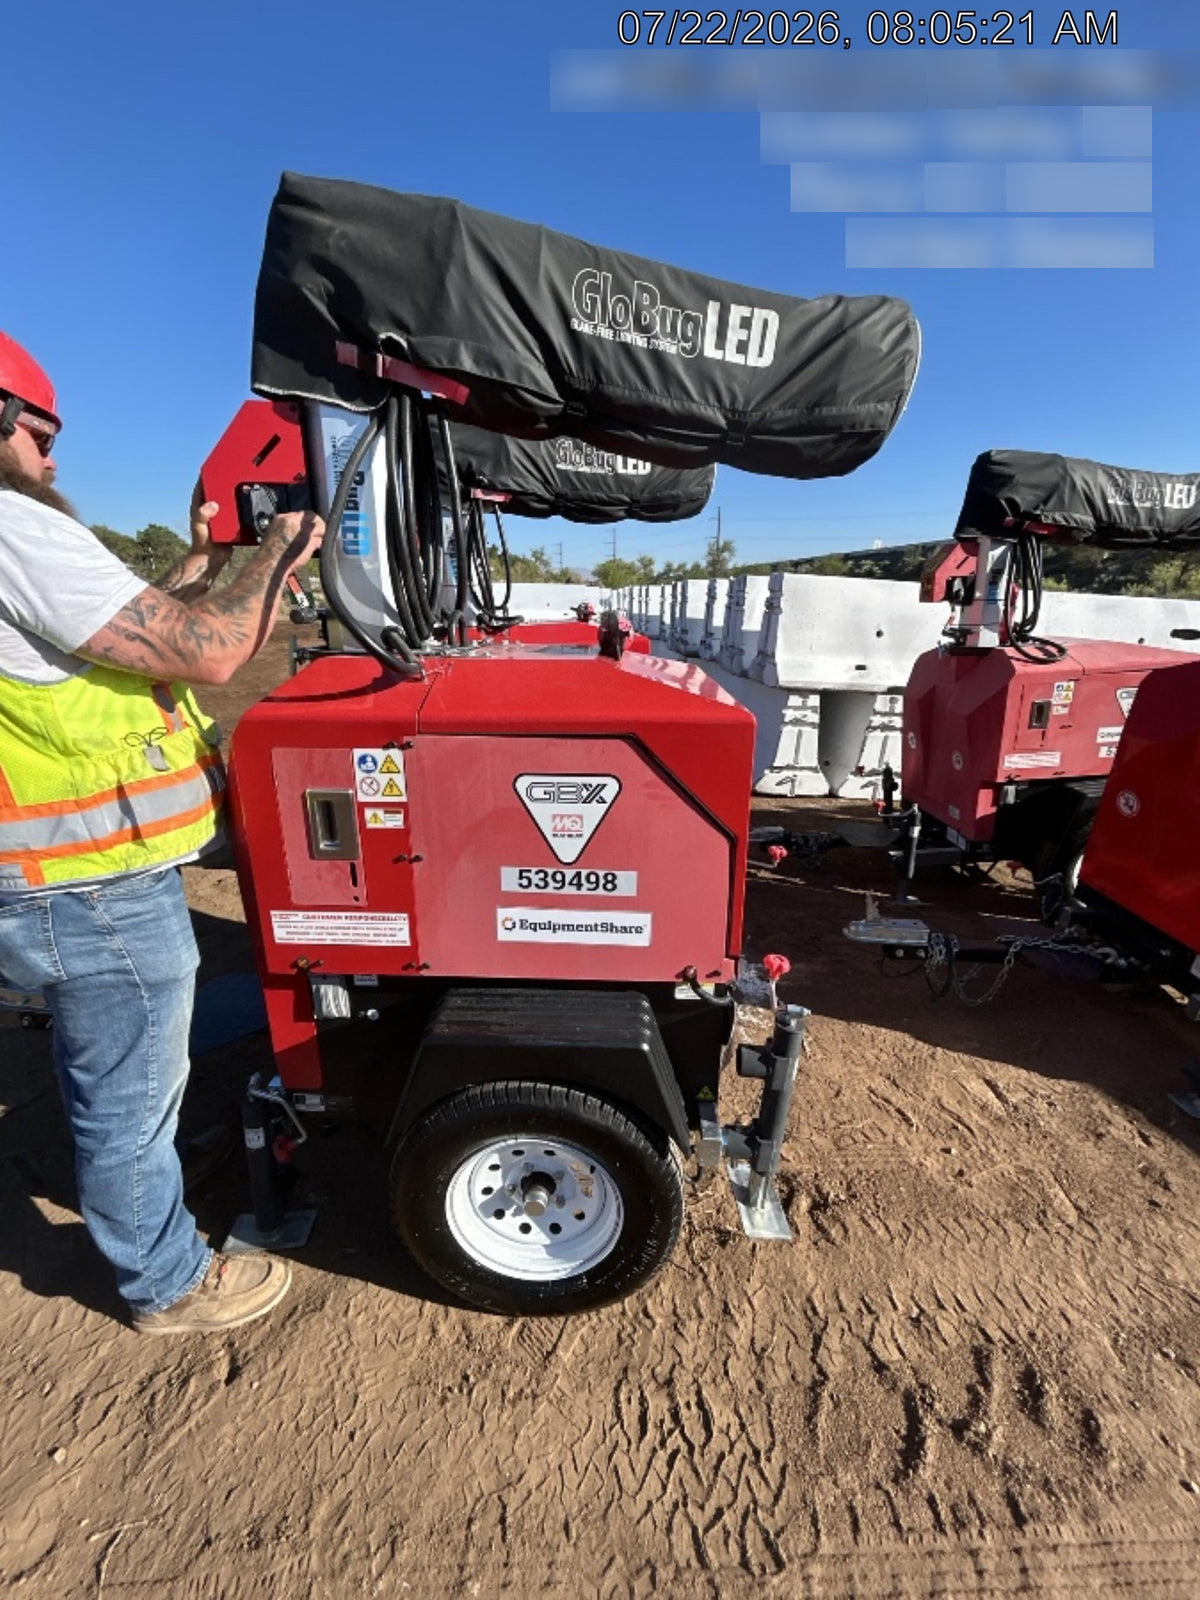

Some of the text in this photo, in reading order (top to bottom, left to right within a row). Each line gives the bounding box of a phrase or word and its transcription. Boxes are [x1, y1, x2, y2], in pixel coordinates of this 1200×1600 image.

[525, 781, 608, 804] GBX
[517, 868, 618, 893] 539498
[518, 918, 644, 935] EquipmentShare
